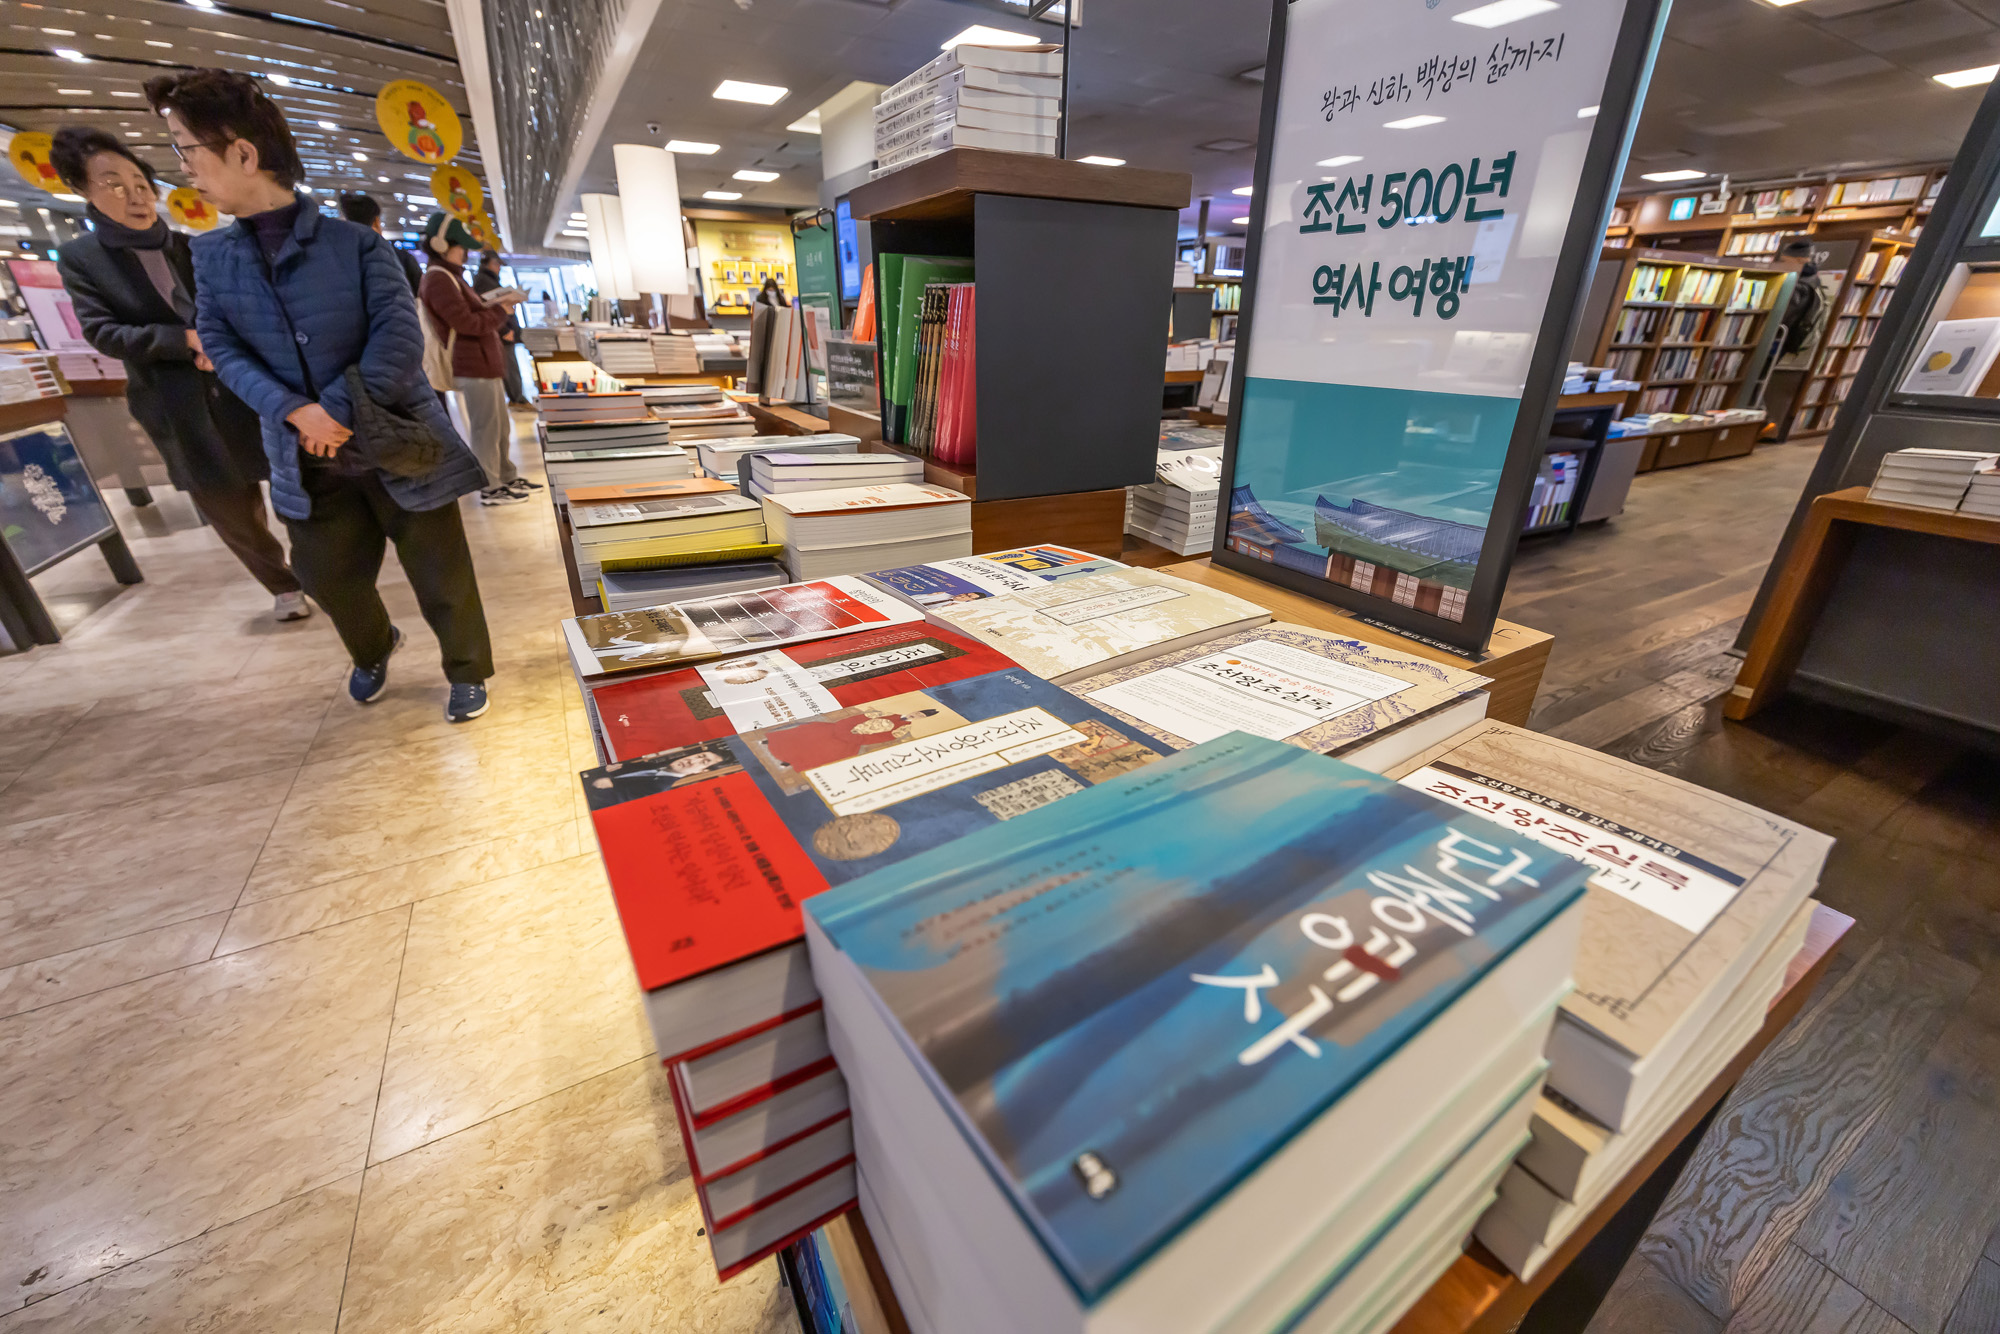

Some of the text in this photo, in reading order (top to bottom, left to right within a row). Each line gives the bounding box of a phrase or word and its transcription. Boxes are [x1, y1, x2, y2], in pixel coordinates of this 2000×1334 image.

[1320, 33, 1565, 122] 왕과 신하, 백성의 삶까지
[1299, 150, 1517, 235] 조선 500년
[1312, 255, 1475, 320] 역사 여행
[1193, 662, 1333, 711] 조선왕조실록
[847, 715, 1044, 785] 조선왕조실록
[1472, 775, 1562, 811] 조선왕조실록
[1425, 779, 1691, 893] 조선왕조실록
[1191, 826, 1541, 1066] 단종애사
